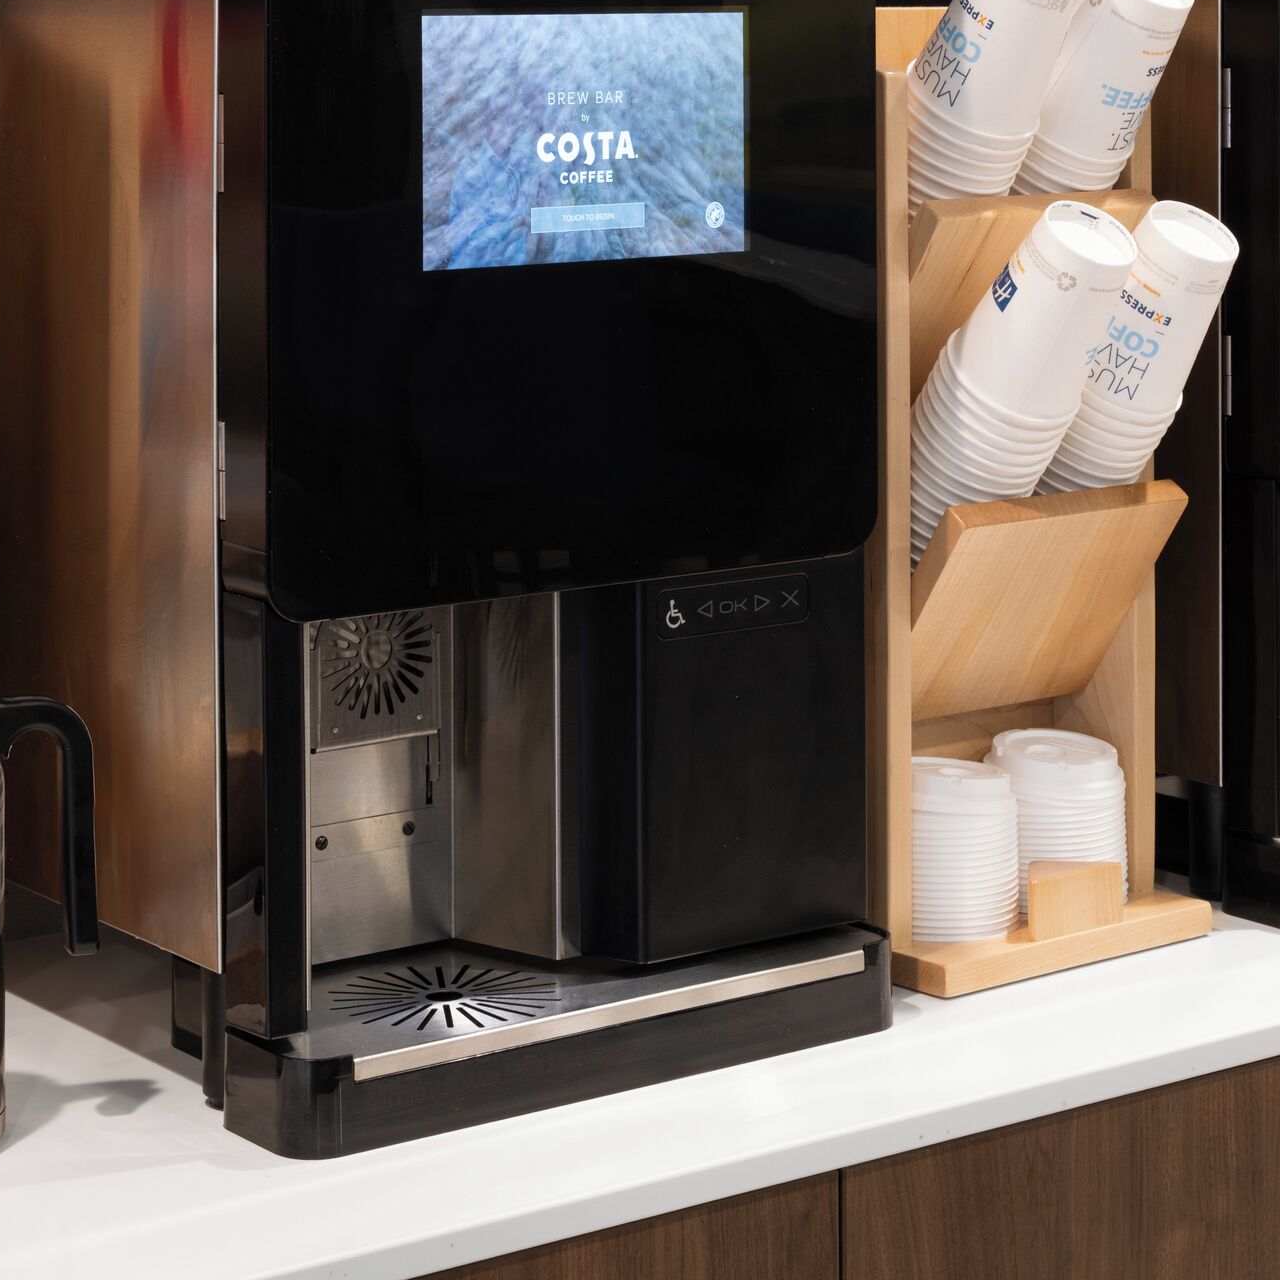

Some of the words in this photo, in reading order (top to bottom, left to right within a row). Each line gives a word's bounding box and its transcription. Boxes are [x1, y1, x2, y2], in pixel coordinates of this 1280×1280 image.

[547, 91, 589, 105] BREW
[595, 90, 624, 104] BAR
[581, 113, 590, 122] by
[560, 170, 614, 184] COFFEE
[563, 214, 585, 222] TOUCH
[595, 212, 615, 220] BEGIN
[1120, 289, 1173, 327] EXPRESS
[719, 598, 748, 614] OK
